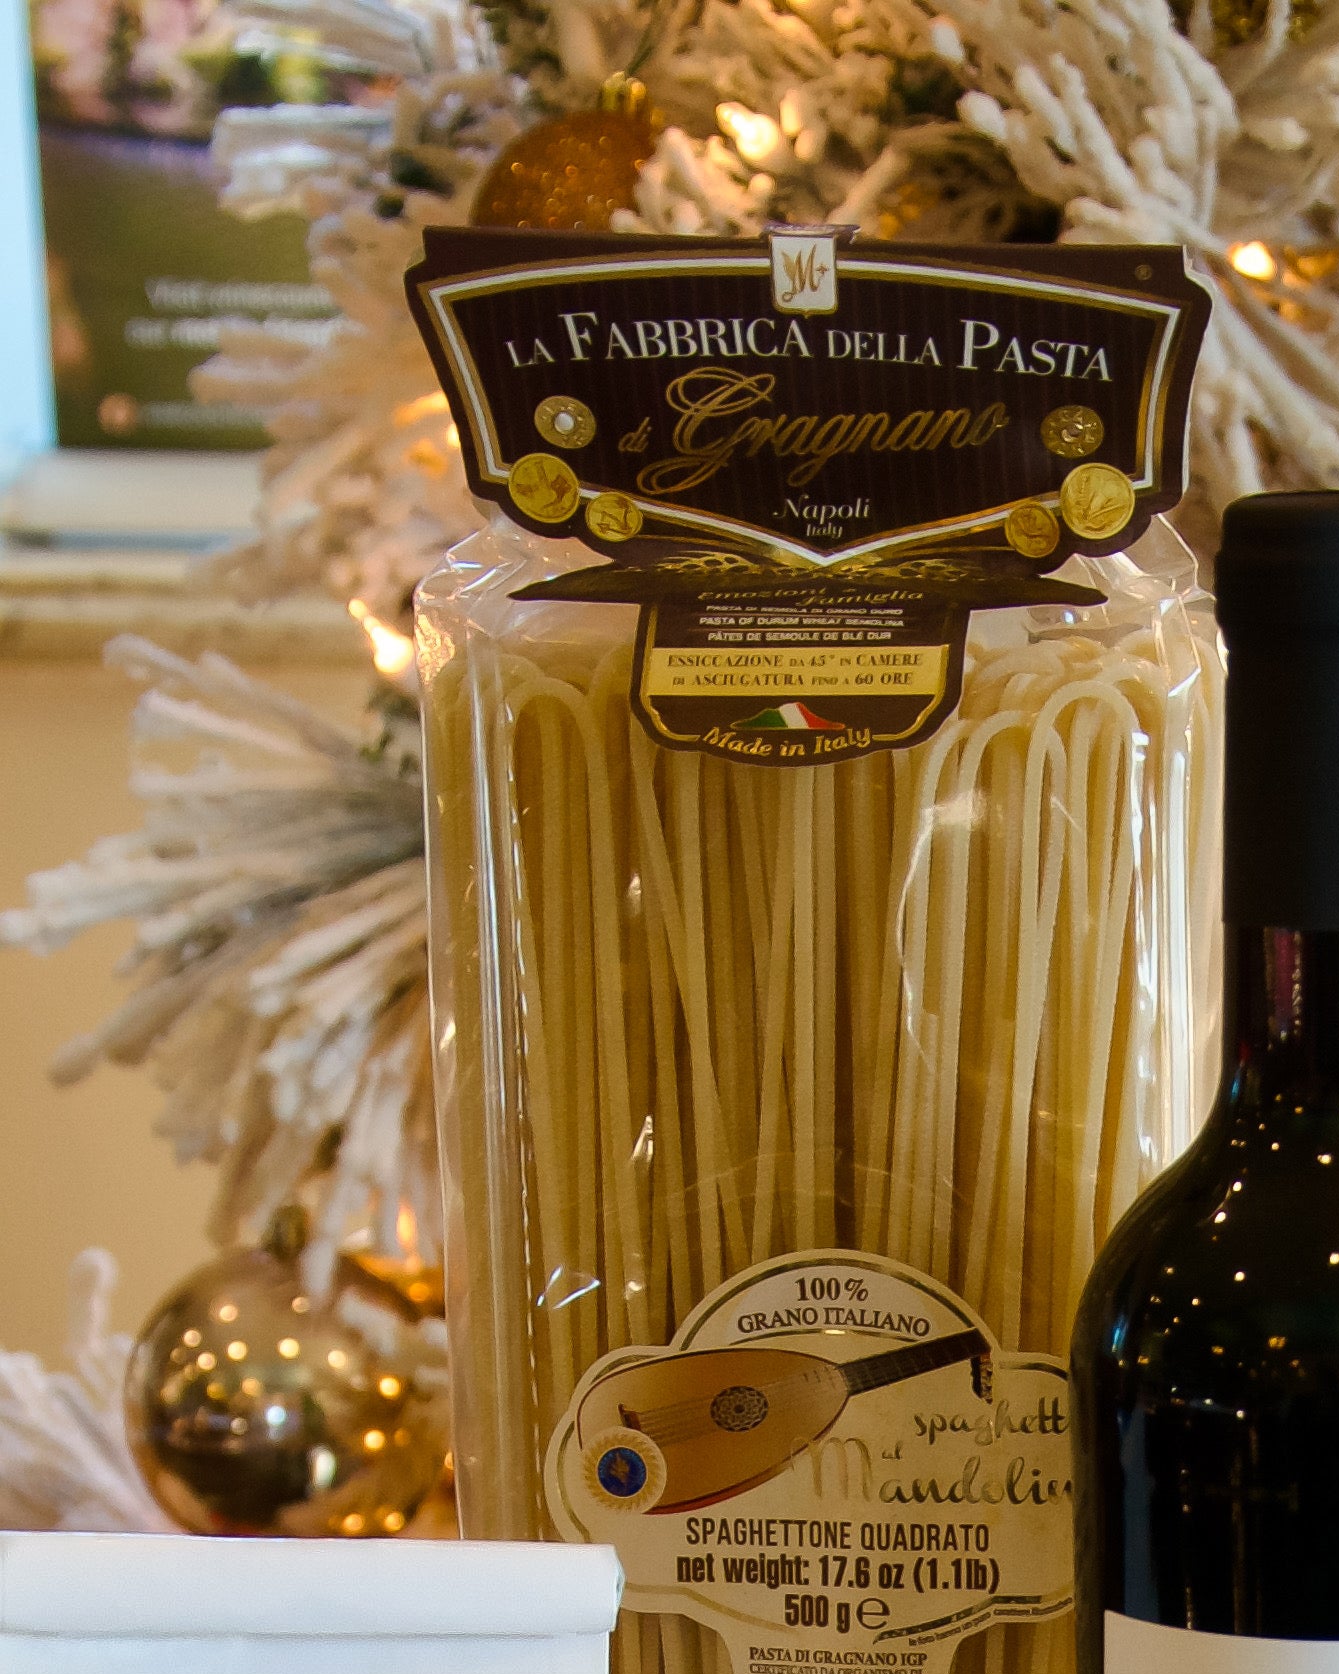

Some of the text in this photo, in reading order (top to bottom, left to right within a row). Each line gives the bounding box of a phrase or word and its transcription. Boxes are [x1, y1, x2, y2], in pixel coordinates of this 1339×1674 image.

[504, 311, 1113, 382] LA FABBRICA DELLA PASTA
[616, 366, 1011, 495] di Gragnano
[773, 496, 871, 526] Napoli
[806, 523, 844, 539] Italy
[699, 616, 736, 627] PASTA
[667, 653, 785, 668] ESSICCAZIONE
[856, 653, 924, 668] CAMERE
[691, 672, 805, 687] ASCIUGATURA
[853, 672, 874, 686] 60
[880, 672, 914, 686] ORE
[701, 725, 873, 758] Made in Italy
[794, 1276, 869, 1303] 100%
[737, 1306, 931, 1338] GRANO ITALIANO
[913, 1396, 1070, 1447] spaghett
[791, 1436, 1074, 1506] Mandolin
[685, 1516, 991, 1553] SPAGHETTONE QUADRATO
[676, 1552, 1001, 1595] net weight: 17.6 oz (1.1lb)
[784, 1594, 830, 1628] 500
[749, 1646, 928, 1667] PASTA DI GRAGNANO IGP
